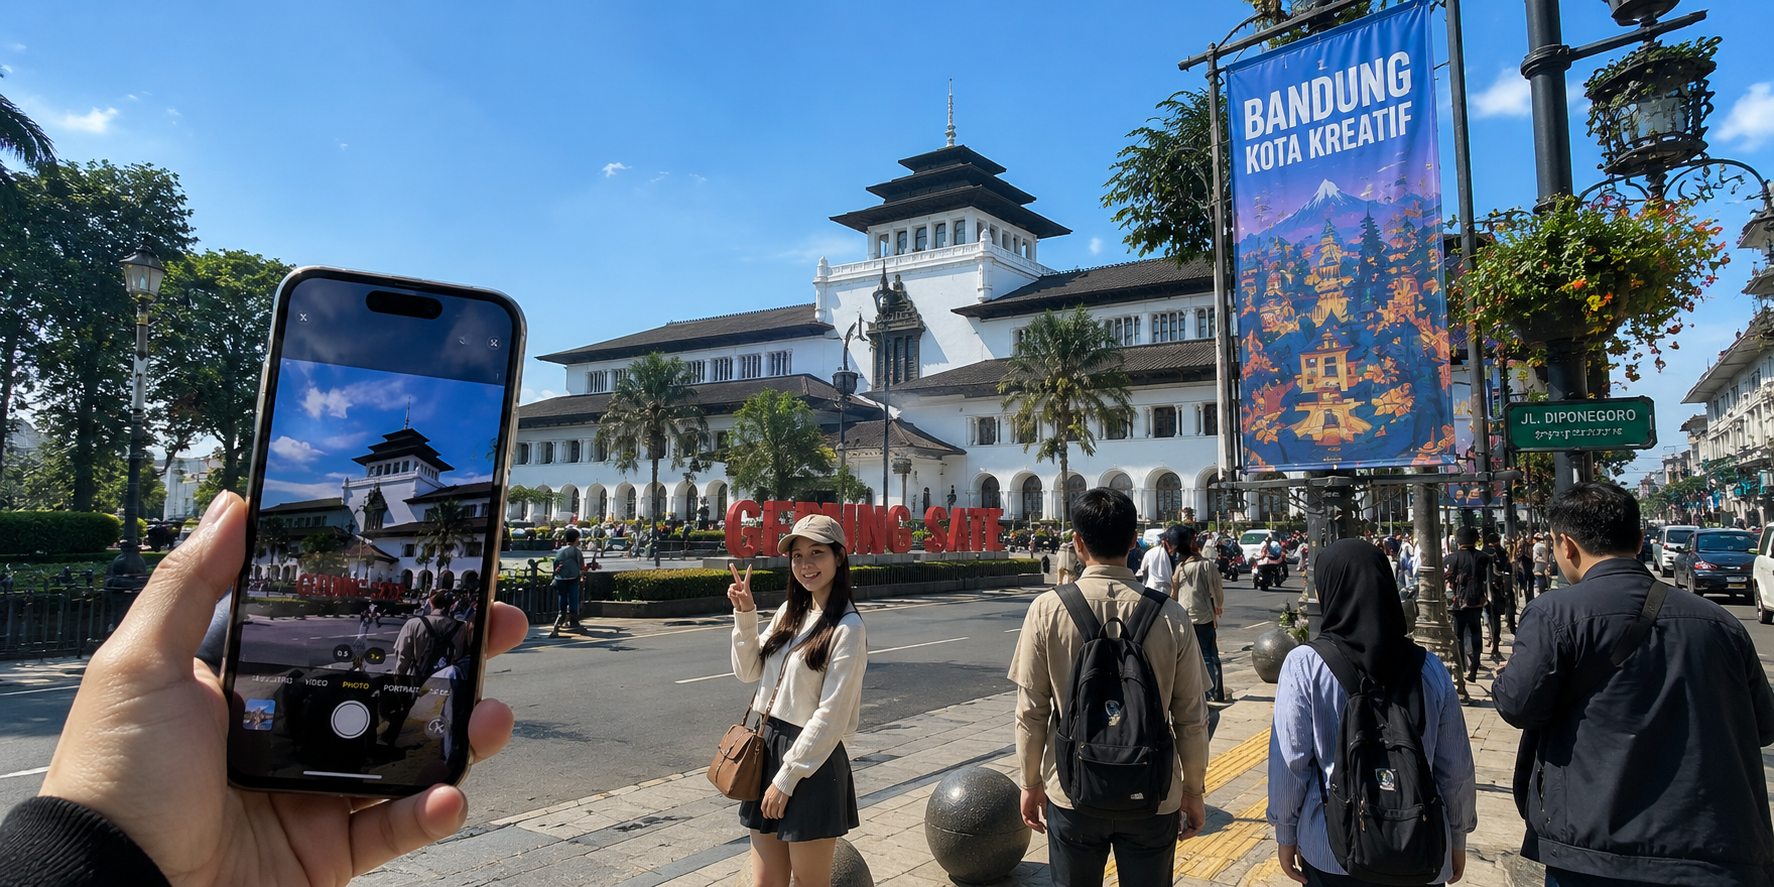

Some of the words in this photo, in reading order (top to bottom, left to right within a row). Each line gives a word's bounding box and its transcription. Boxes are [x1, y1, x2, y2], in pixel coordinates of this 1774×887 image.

[1244, 51, 1412, 140] BANDUNG
[1245, 133, 1302, 175] KOTA
[1308, 100, 1412, 159] KREATIF
[1520, 413, 1540, 425] JL.
[1545, 409, 1636, 424] DIPONEGORO
[923, 506, 1005, 552] SATE
[342, 681, 369, 690] PHOTO
[383, 684, 420, 693] PORTRAIT
